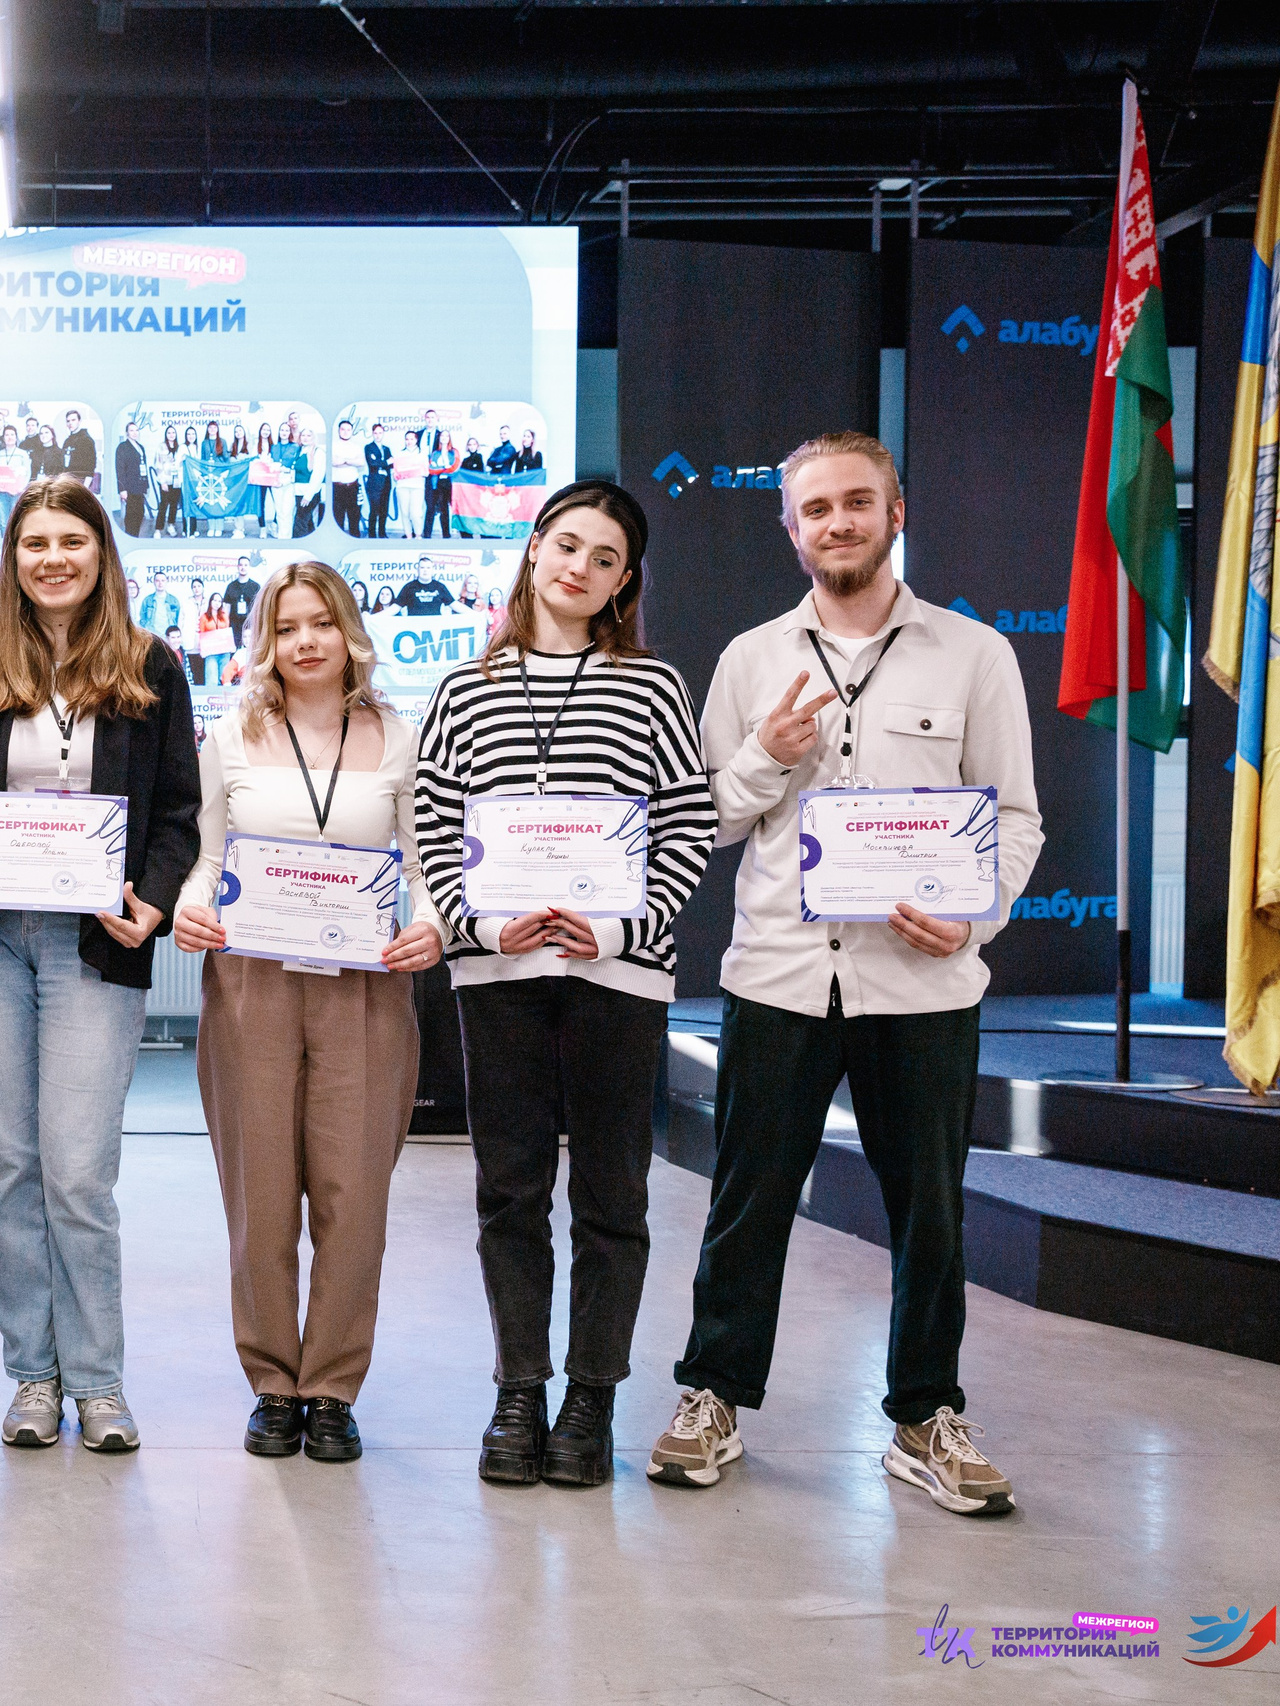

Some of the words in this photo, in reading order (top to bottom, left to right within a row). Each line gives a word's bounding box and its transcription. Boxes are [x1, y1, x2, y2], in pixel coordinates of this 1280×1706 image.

[83, 245, 237, 275] МЕЖРЕГИОН
[998, 315, 1100, 356] алабу
[507, 824, 604, 834] СЕРТИФИКАТ
[845, 819, 950, 833] СЕРТИФИКАТ
[265, 866, 359, 886] СЕРТИФИКАТ
[290, 881, 327, 890] УЧАСТНИКА
[1008, 887, 1119, 928] лабуга
